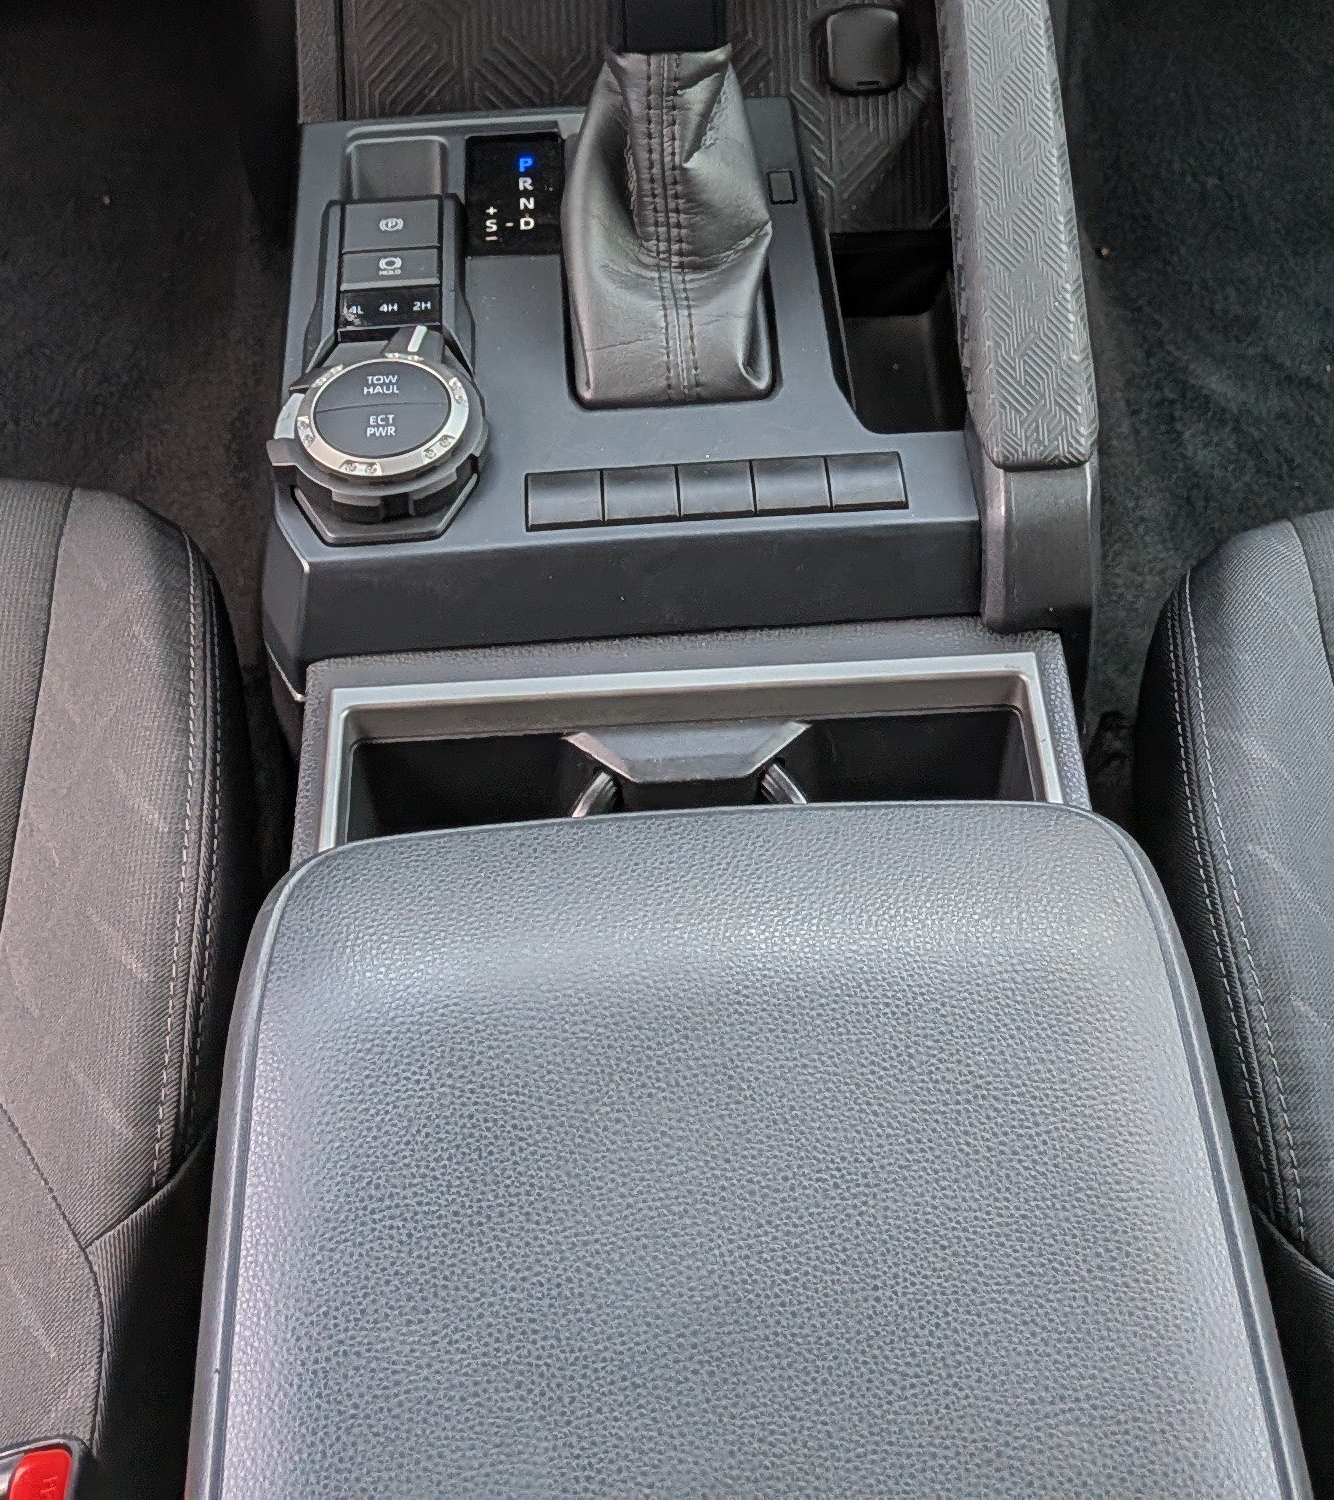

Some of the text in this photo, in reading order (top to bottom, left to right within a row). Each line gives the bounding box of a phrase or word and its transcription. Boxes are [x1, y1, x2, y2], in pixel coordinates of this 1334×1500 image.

[518, 157, 533, 172] P
[518, 176, 534, 191] R
[519, 196, 535, 211] N
[485, 217, 535, 233] S D
[348, 304, 364, 315] 4L
[379, 302, 398, 313] 4H
[412, 301, 431, 311] 2H
[366, 374, 398, 385] TOW
[363, 385, 400, 395] HAUL
[369, 414, 395, 425] ECT
[366, 426, 396, 438] PWR
